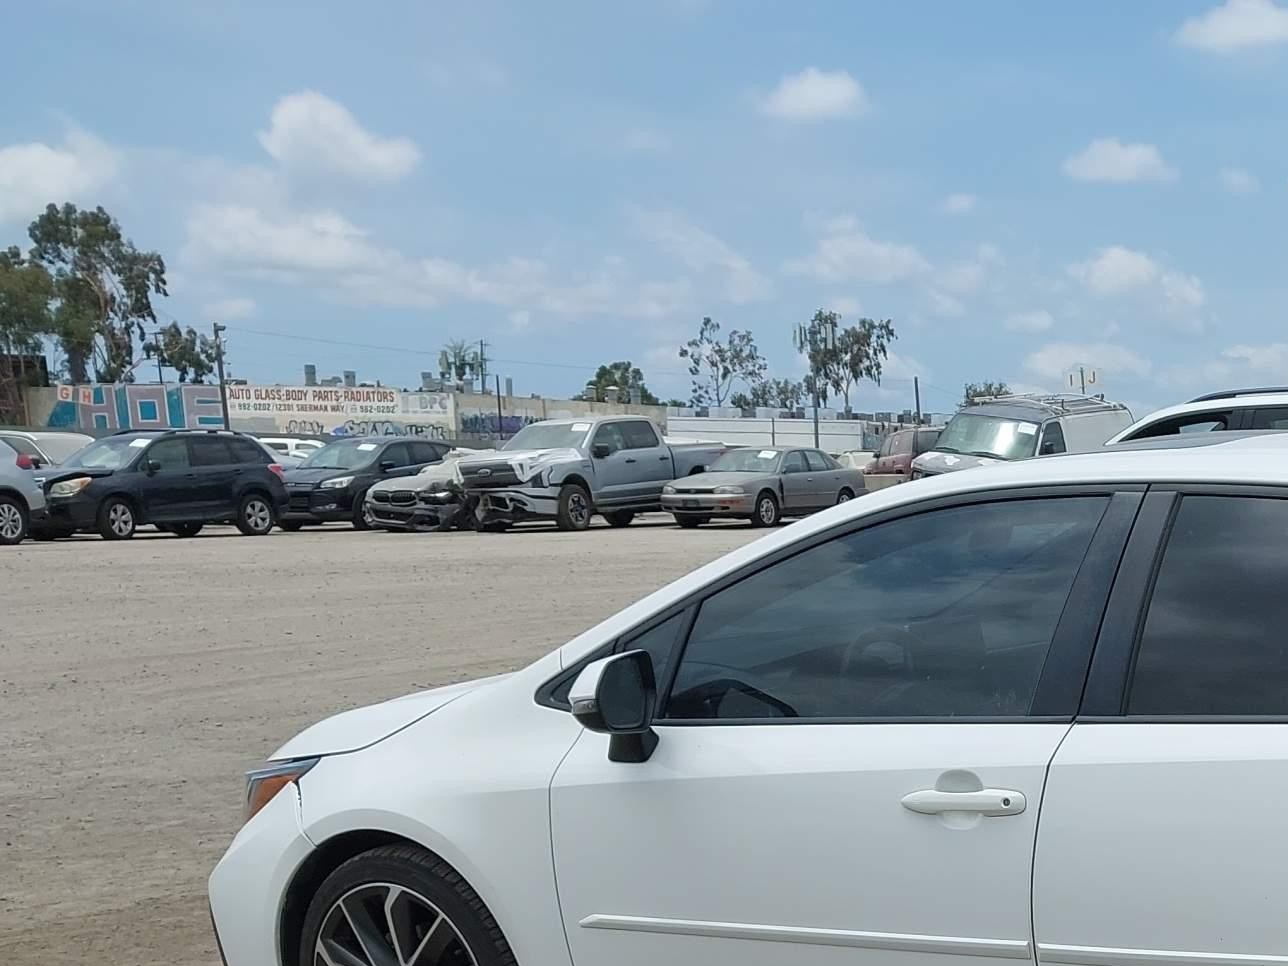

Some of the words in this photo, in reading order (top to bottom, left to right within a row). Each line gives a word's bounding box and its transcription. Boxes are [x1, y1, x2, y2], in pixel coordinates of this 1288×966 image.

[1088, 370, 1096, 384] J
[59, 388, 70, 400] G
[81, 392, 91, 402] H
[229, 387, 251, 400] AUTO
